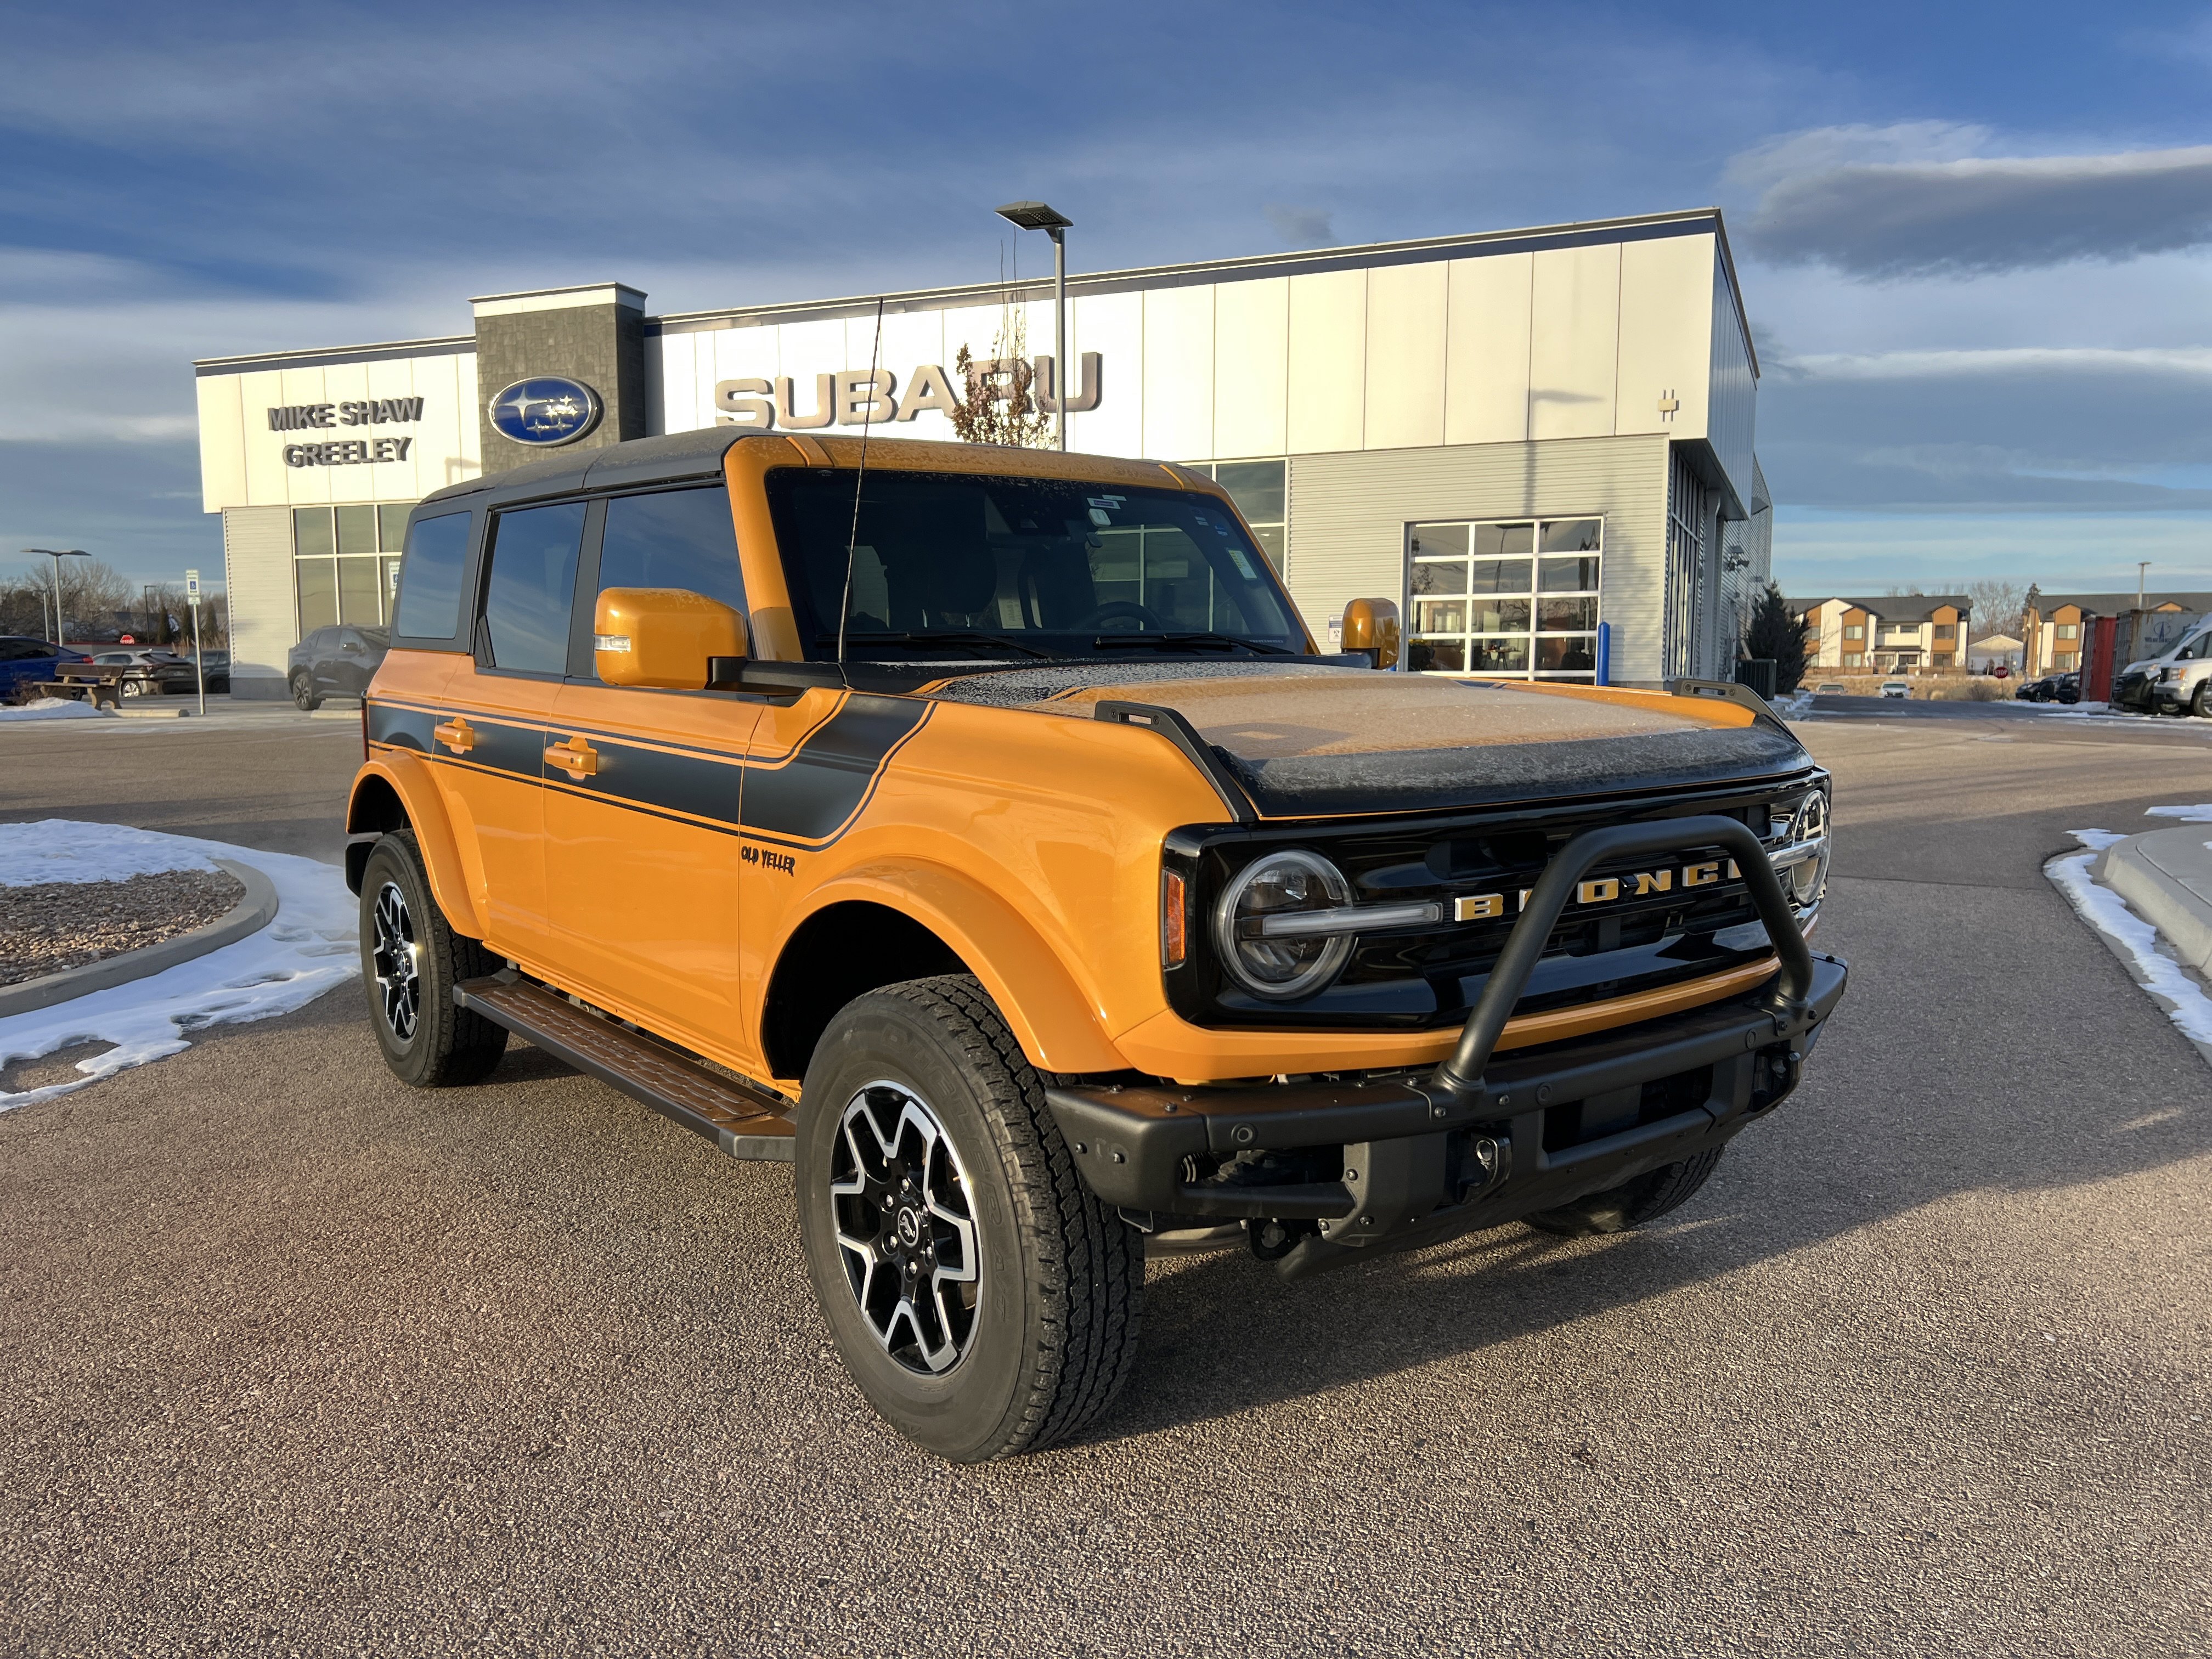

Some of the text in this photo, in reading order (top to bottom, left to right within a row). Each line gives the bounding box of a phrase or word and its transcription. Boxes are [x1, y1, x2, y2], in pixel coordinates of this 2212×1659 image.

[268, 397, 424, 431] MIKE SHAW
[283, 437, 413, 467] GREELEY
[742, 846, 795, 877] OLD YELLER
[1454, 857, 1742, 922] BONC
